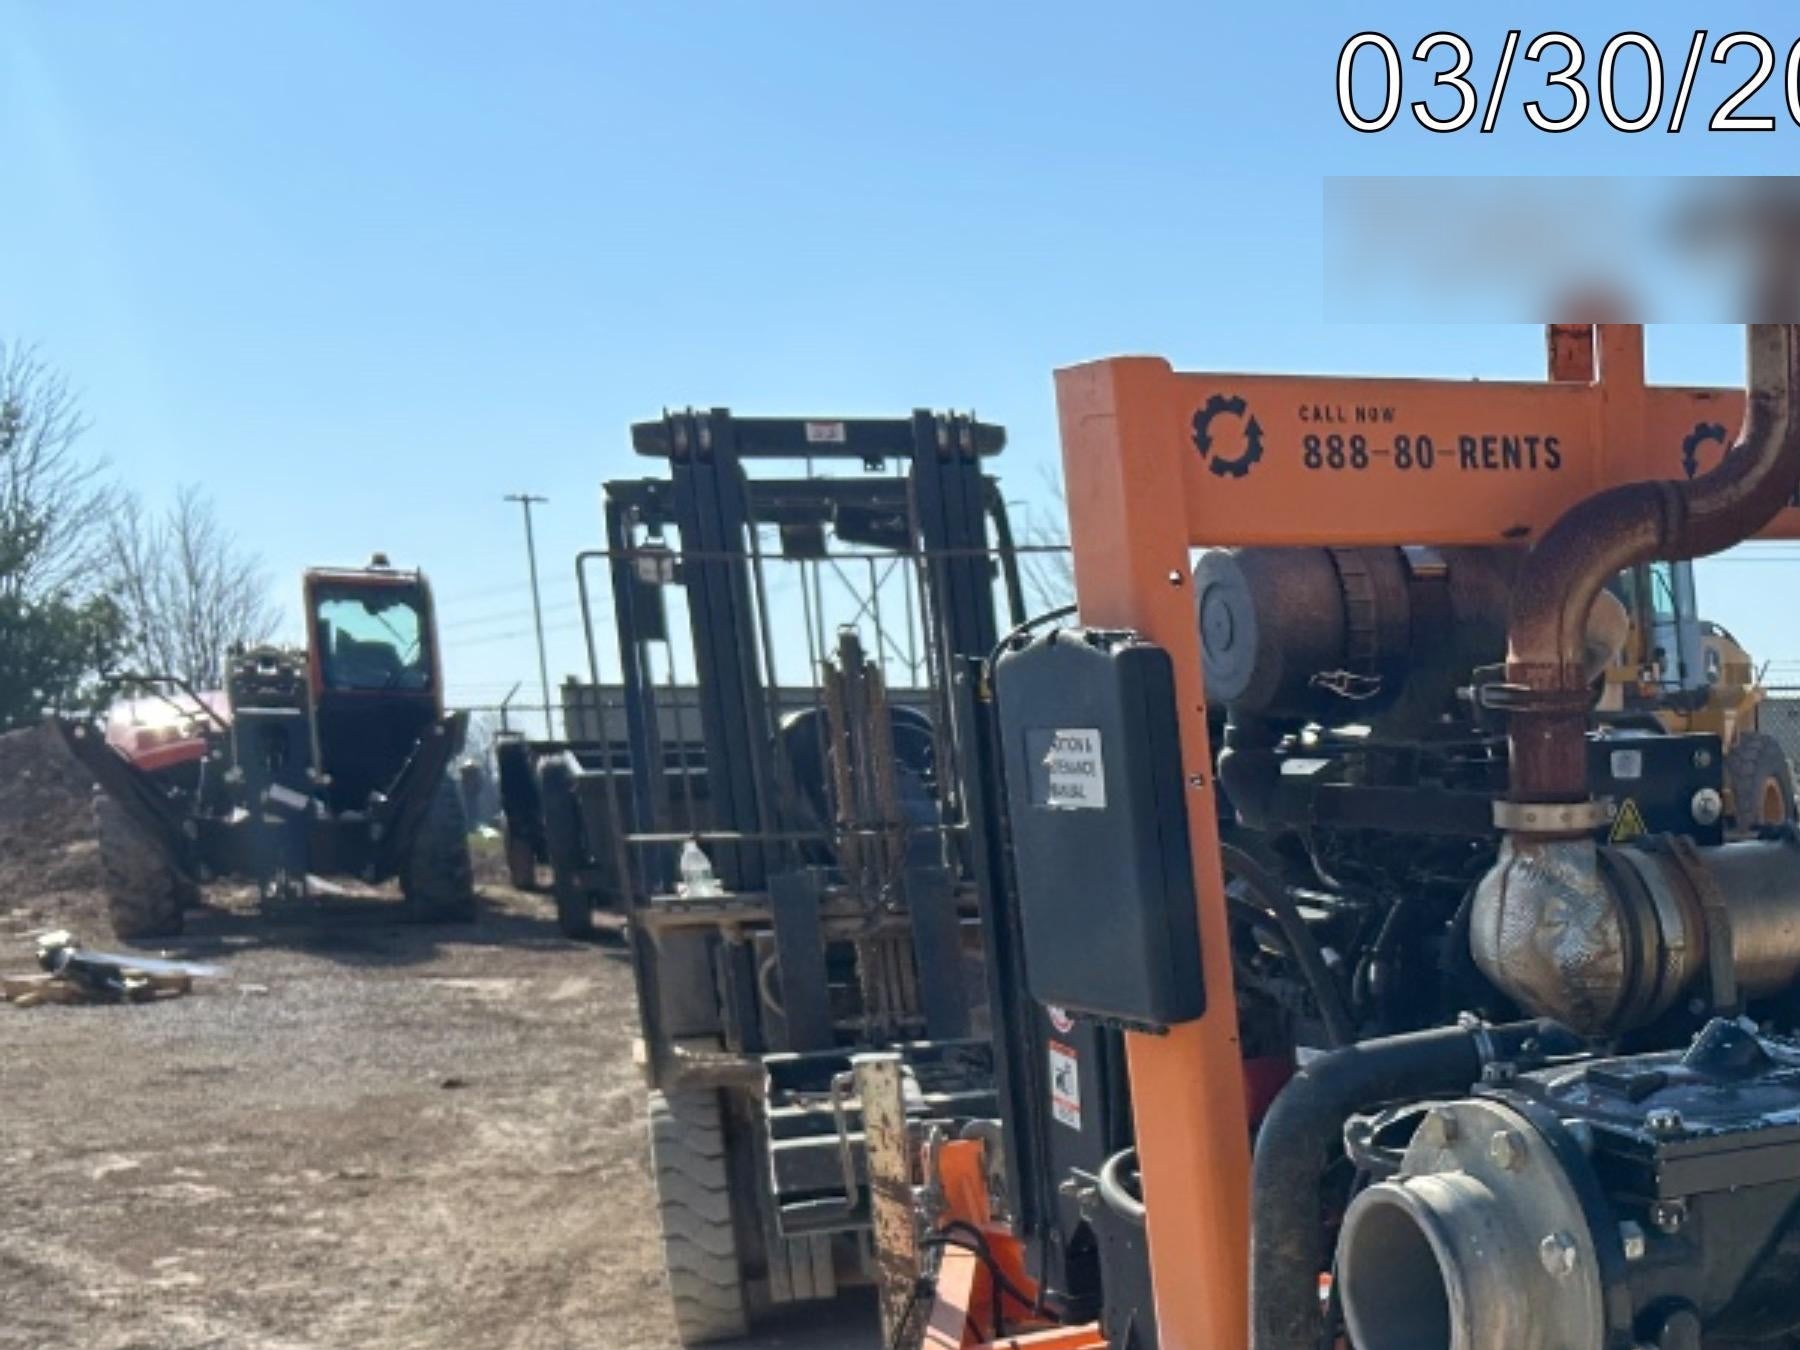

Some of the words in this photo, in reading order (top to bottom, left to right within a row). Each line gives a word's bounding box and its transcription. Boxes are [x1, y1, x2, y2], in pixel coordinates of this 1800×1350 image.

[1298, 404, 1347, 423] CALL
[1355, 406, 1396, 423] NOW
[1303, 433, 1562, 470] 888-80-RENTS
